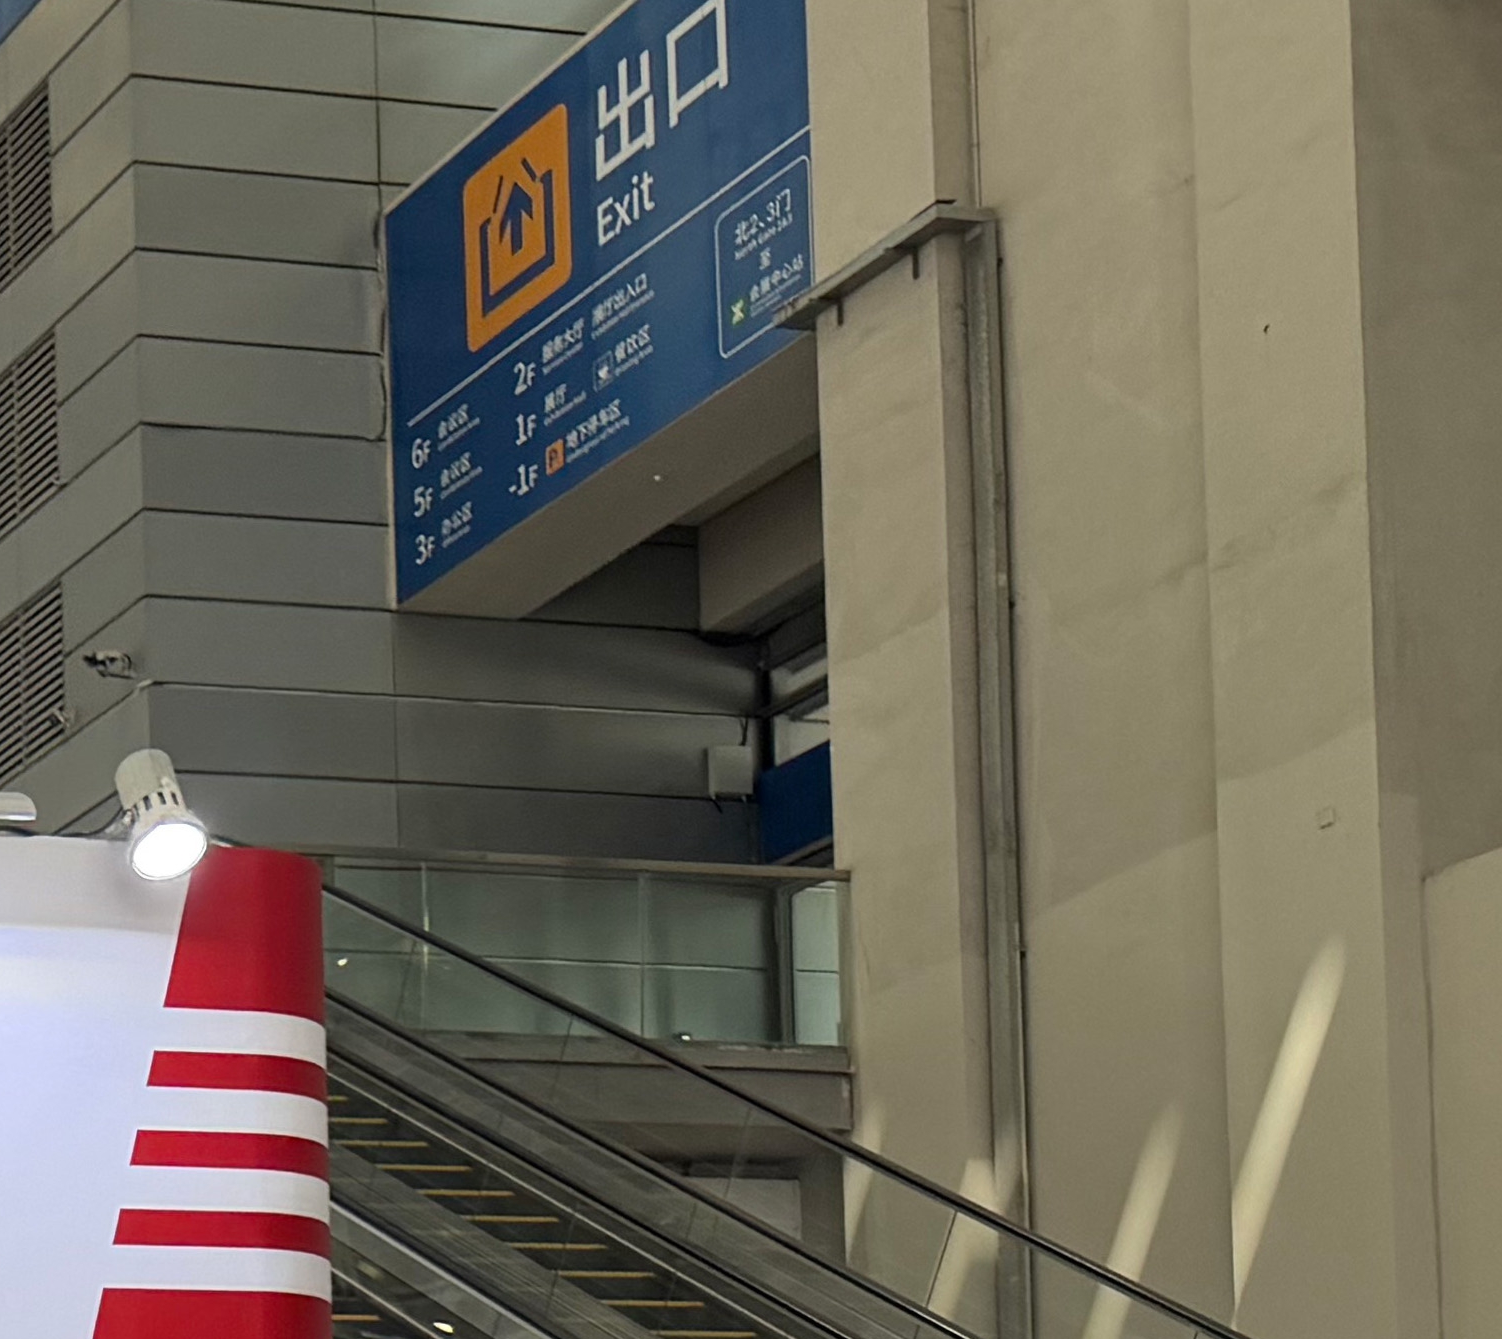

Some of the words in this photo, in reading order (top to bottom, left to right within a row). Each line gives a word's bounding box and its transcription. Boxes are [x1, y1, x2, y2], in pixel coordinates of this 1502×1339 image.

[596, 0, 729, 181] 出口
[598, 170, 656, 247] Exit
[513, 361, 536, 395] 2F
[515, 413, 537, 446] 1F
[411, 437, 431, 469] 6F
[508, 463, 538, 495] -1F
[414, 486, 433, 517] 5F
[415, 534, 435, 565] 3F
